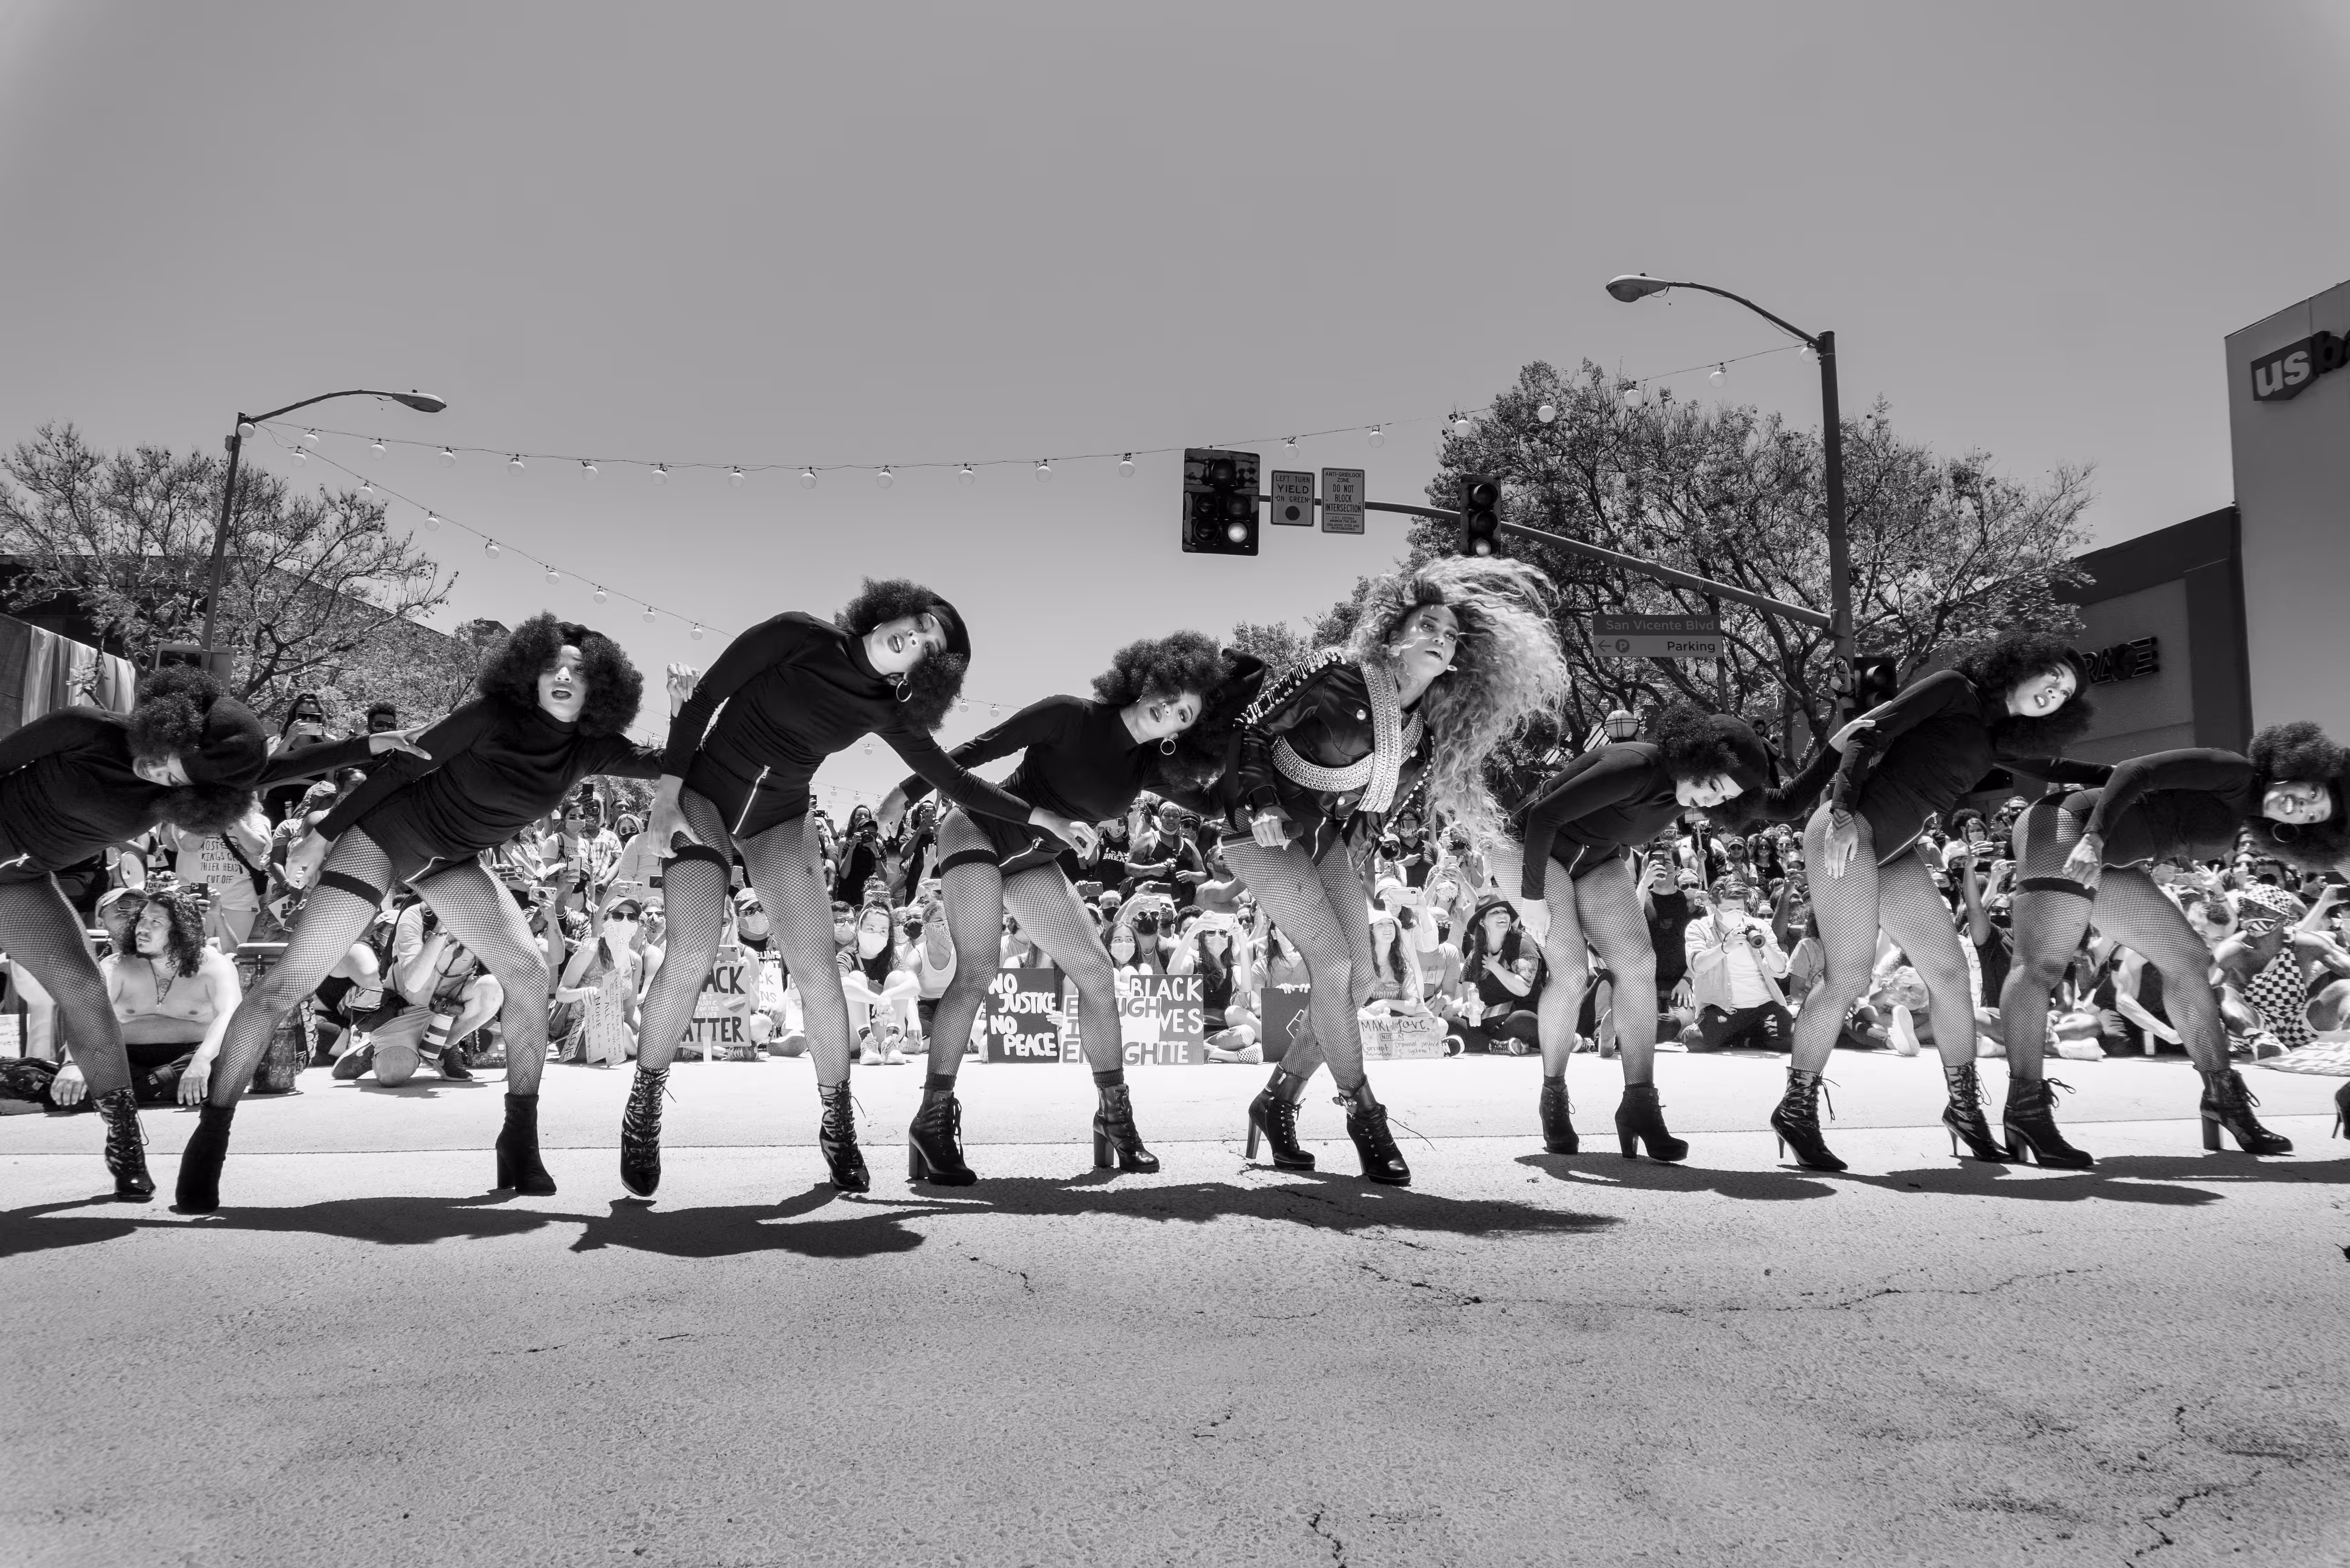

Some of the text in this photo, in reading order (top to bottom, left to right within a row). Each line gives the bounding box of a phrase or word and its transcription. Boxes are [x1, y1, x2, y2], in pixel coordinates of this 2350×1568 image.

[1277, 484, 1309, 494] YIELD
[1333, 484, 1354, 493] DO NOT
[1335, 494, 1352, 503] BLOCK
[1325, 503, 1361, 513] INTERSECTION
[1606, 620, 1714, 630] San Vicente Blvd
[1667, 641, 1716, 653] Parking
[201, 851, 225, 861] KINGS
[206, 875, 221, 883] CUT
[702, 966, 746, 995] ACK
[988, 973, 1018, 995] NO
[1131, 977, 1203, 1002] BLACK
[998, 991, 1056, 1014] JUSTICE
[1066, 997, 1160, 1019] EUGH
[682, 1016, 744, 1042] ATTER
[990, 1015, 1018, 1035] NO
[1160, 1008, 1204, 1034] VES
[1003, 1032, 1057, 1056] PEACE
